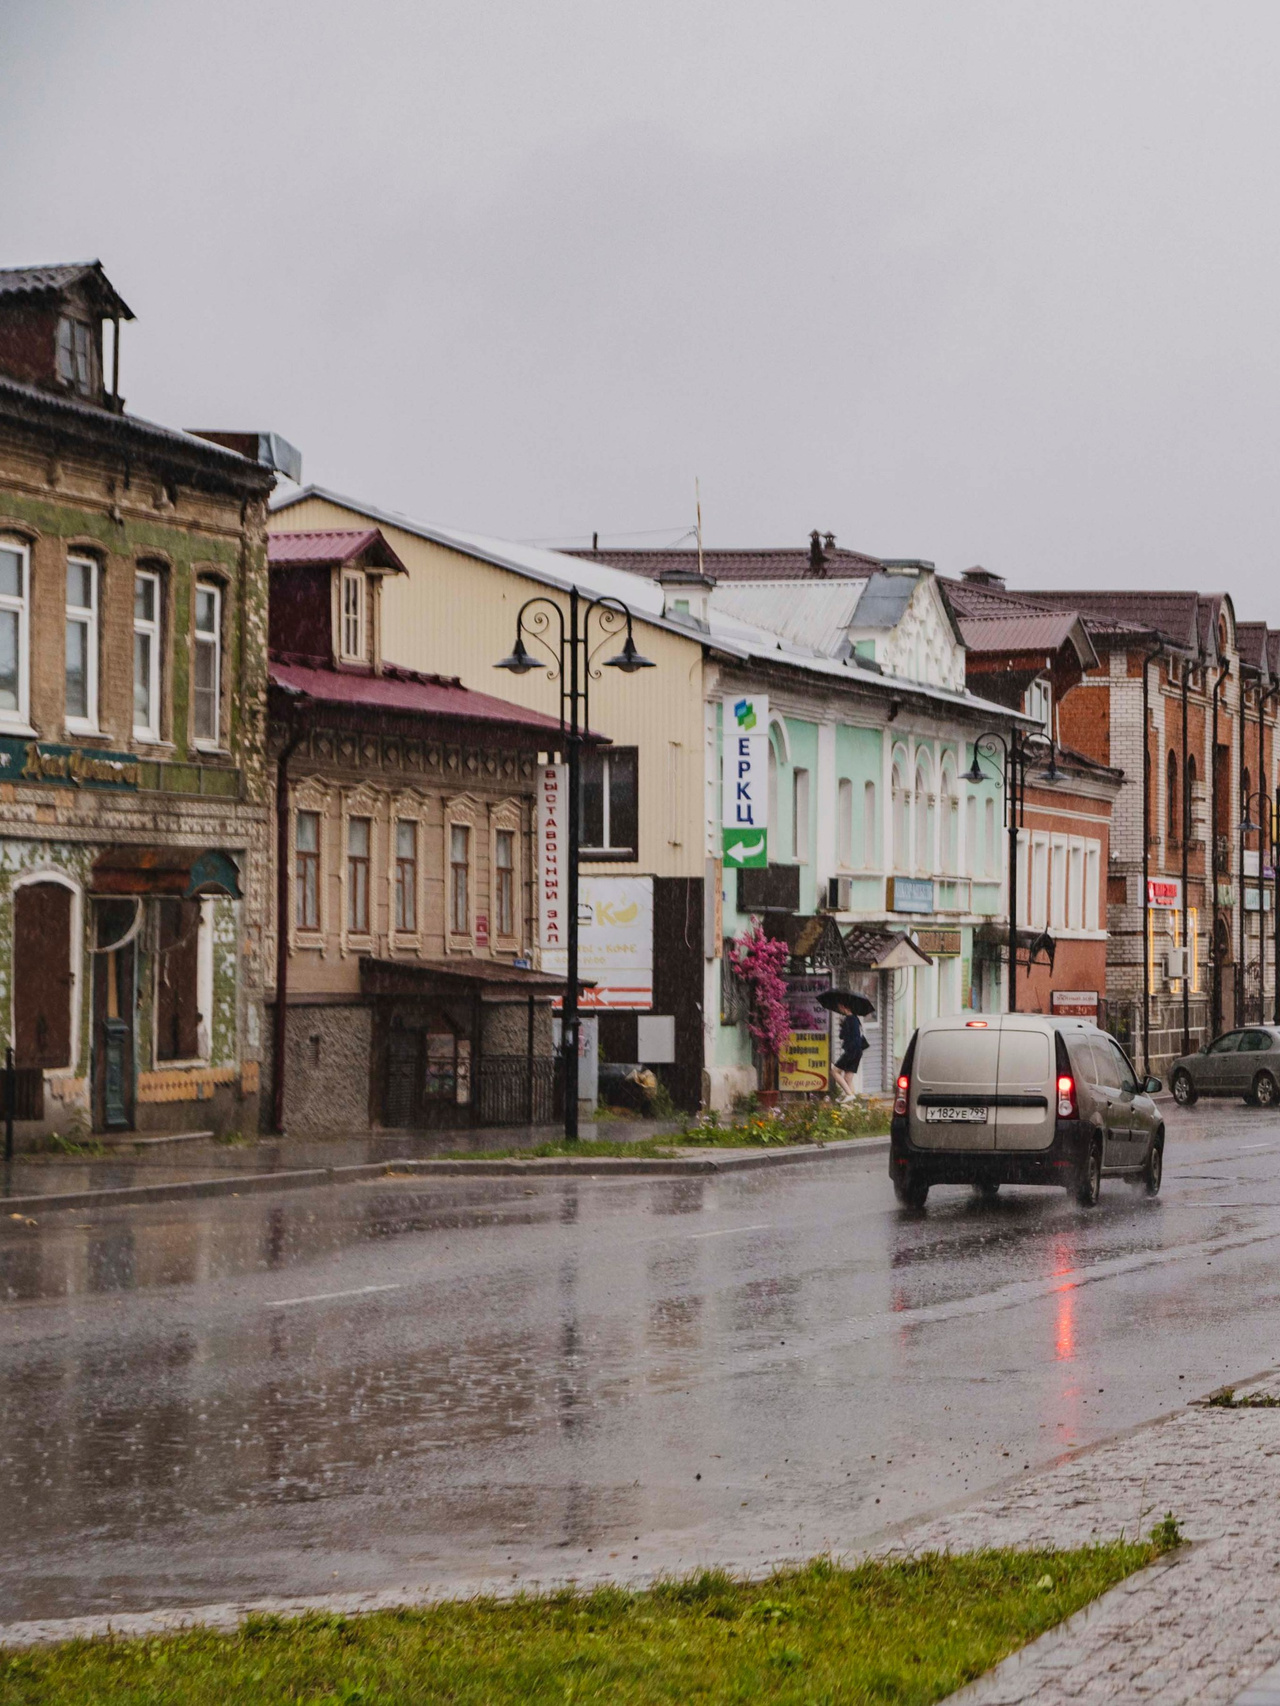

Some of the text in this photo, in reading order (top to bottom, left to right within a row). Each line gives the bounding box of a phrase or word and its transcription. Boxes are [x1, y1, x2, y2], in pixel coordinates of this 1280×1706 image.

[736, 737, 754, 825] ЕРКЦ
[544, 770, 558, 900] ВЫСТАВОЧНЫЙ
[547, 910, 559, 943] ЗАЛ
